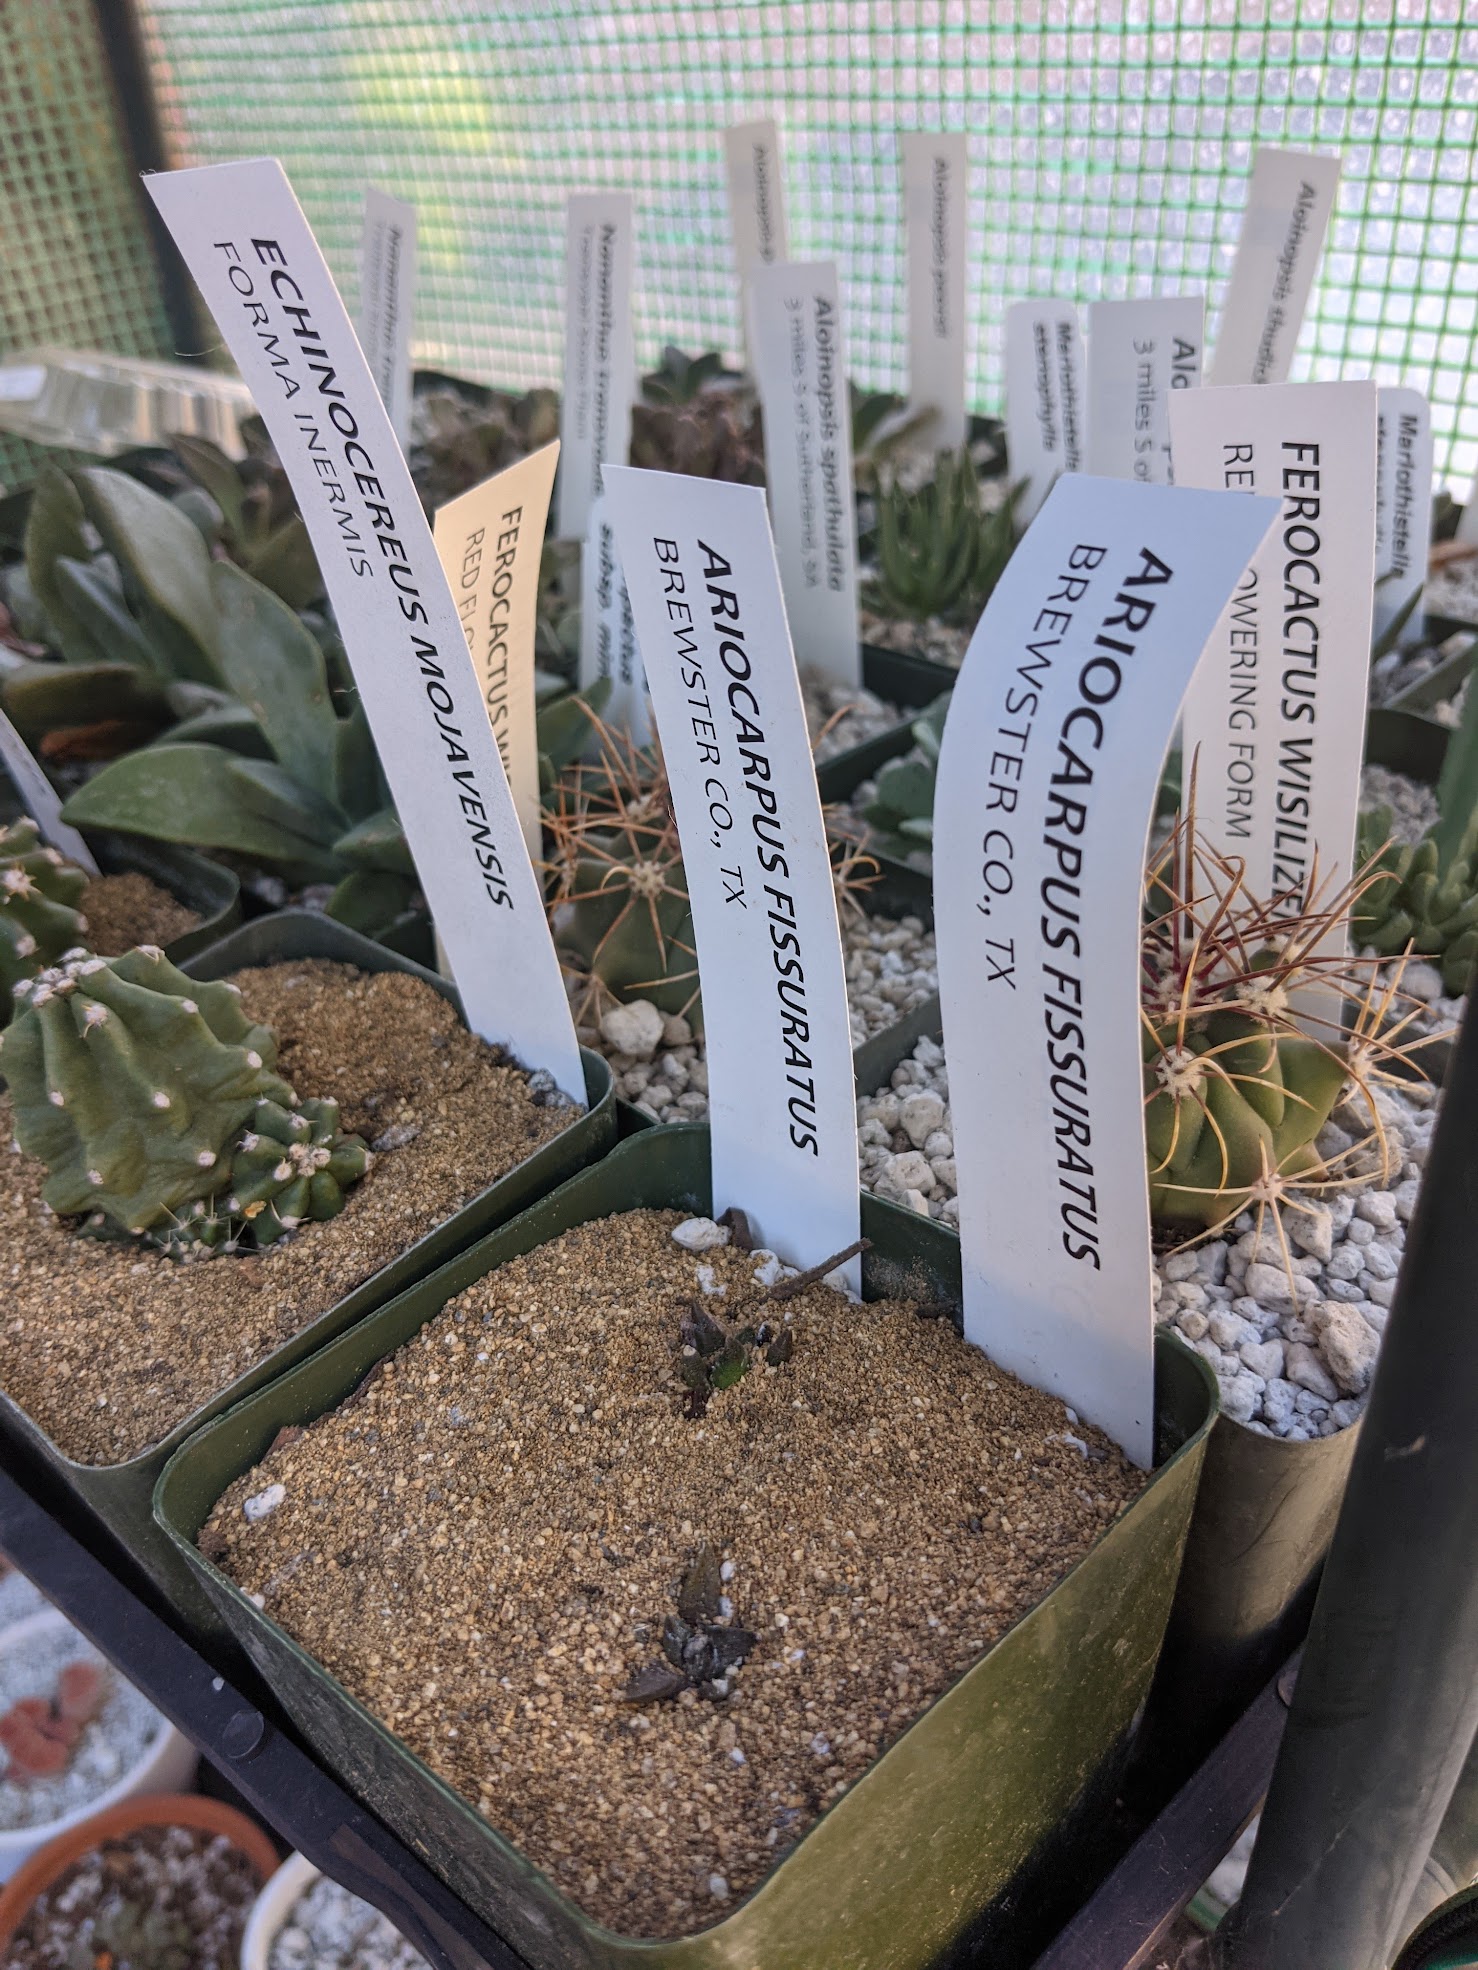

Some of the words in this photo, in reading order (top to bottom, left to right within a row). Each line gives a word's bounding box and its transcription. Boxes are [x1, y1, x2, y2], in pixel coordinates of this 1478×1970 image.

[214, 241, 300, 400] FORMA
[294, 413, 373, 578] INERMIS
[814, 297, 839, 441] Aloinopsis
[1133, 335, 1155, 355] 3
[1135, 362, 1157, 431] miles
[1134, 438, 1153, 454] S
[1223, 444, 1255, 494] RE
[251, 238, 429, 625] ECHINOCEREUS
[410, 635, 514, 910] MOJAVENSIS
[461, 527, 485, 589] RED
[487, 505, 523, 725] FEROCACTUS
[1280, 442, 1320, 724] FEROCACTUS
[653, 537, 721, 766] BREWSTER
[705, 777, 733, 848] CO.,
[720, 865, 747, 909] TX
[985, 544, 1107, 814] BREWSTER
[1040, 546, 1173, 959] ARIOCARPUS
[697, 538, 790, 878] ARIOCARPUS
[763, 884, 818, 1156] FISSURATUS
[976, 829, 1013, 916] CO.,
[1225, 742, 1254, 838] FORM
[985, 938, 1016, 990] TX
[1042, 963, 1101, 1271] FISSURATUS
